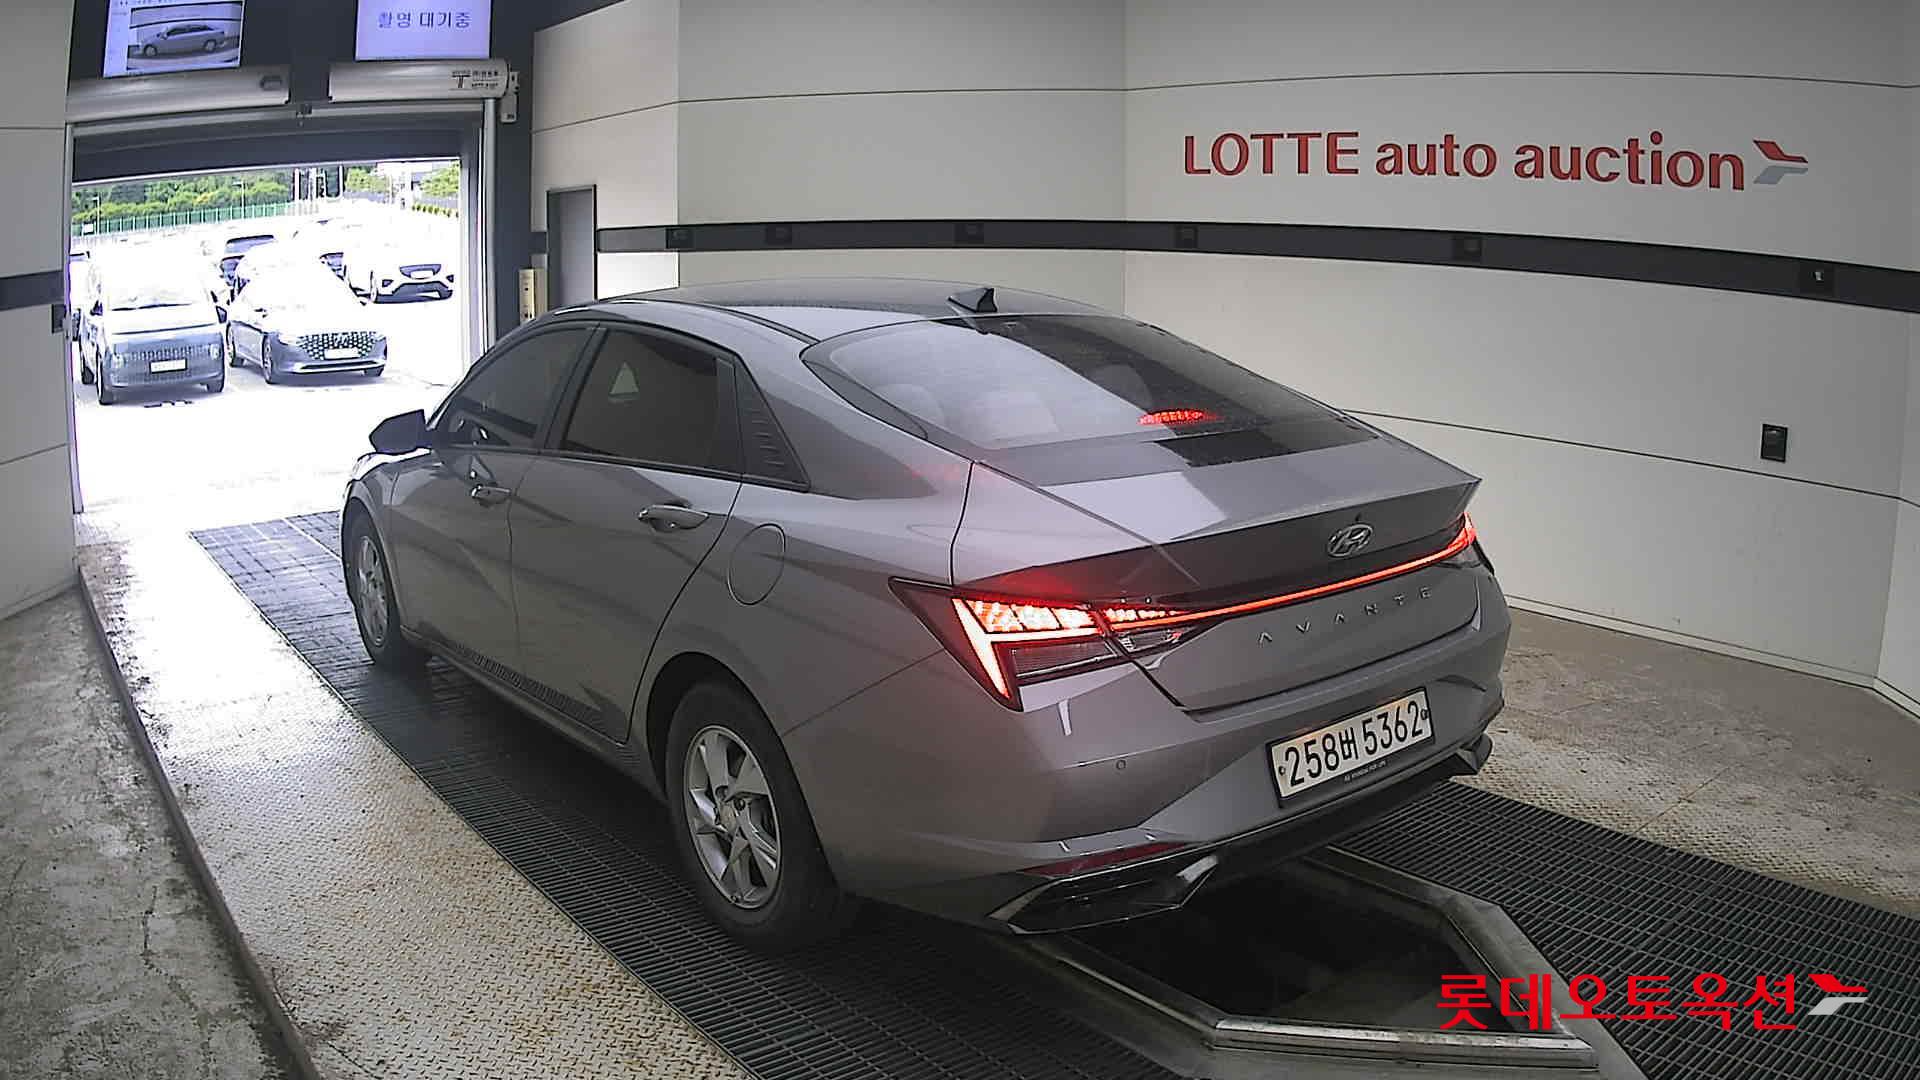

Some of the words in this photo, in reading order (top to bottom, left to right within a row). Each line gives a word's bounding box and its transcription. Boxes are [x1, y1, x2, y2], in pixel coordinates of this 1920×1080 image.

[419, 11, 472, 29] 대기중
[1184, 131, 1359, 175] LOTTE
[1375, 133, 1497, 177] auto
[1514, 131, 1745, 190] auction
[1258, 586, 1432, 646] AVANTE
[1361, 700, 1424, 755] 5362
